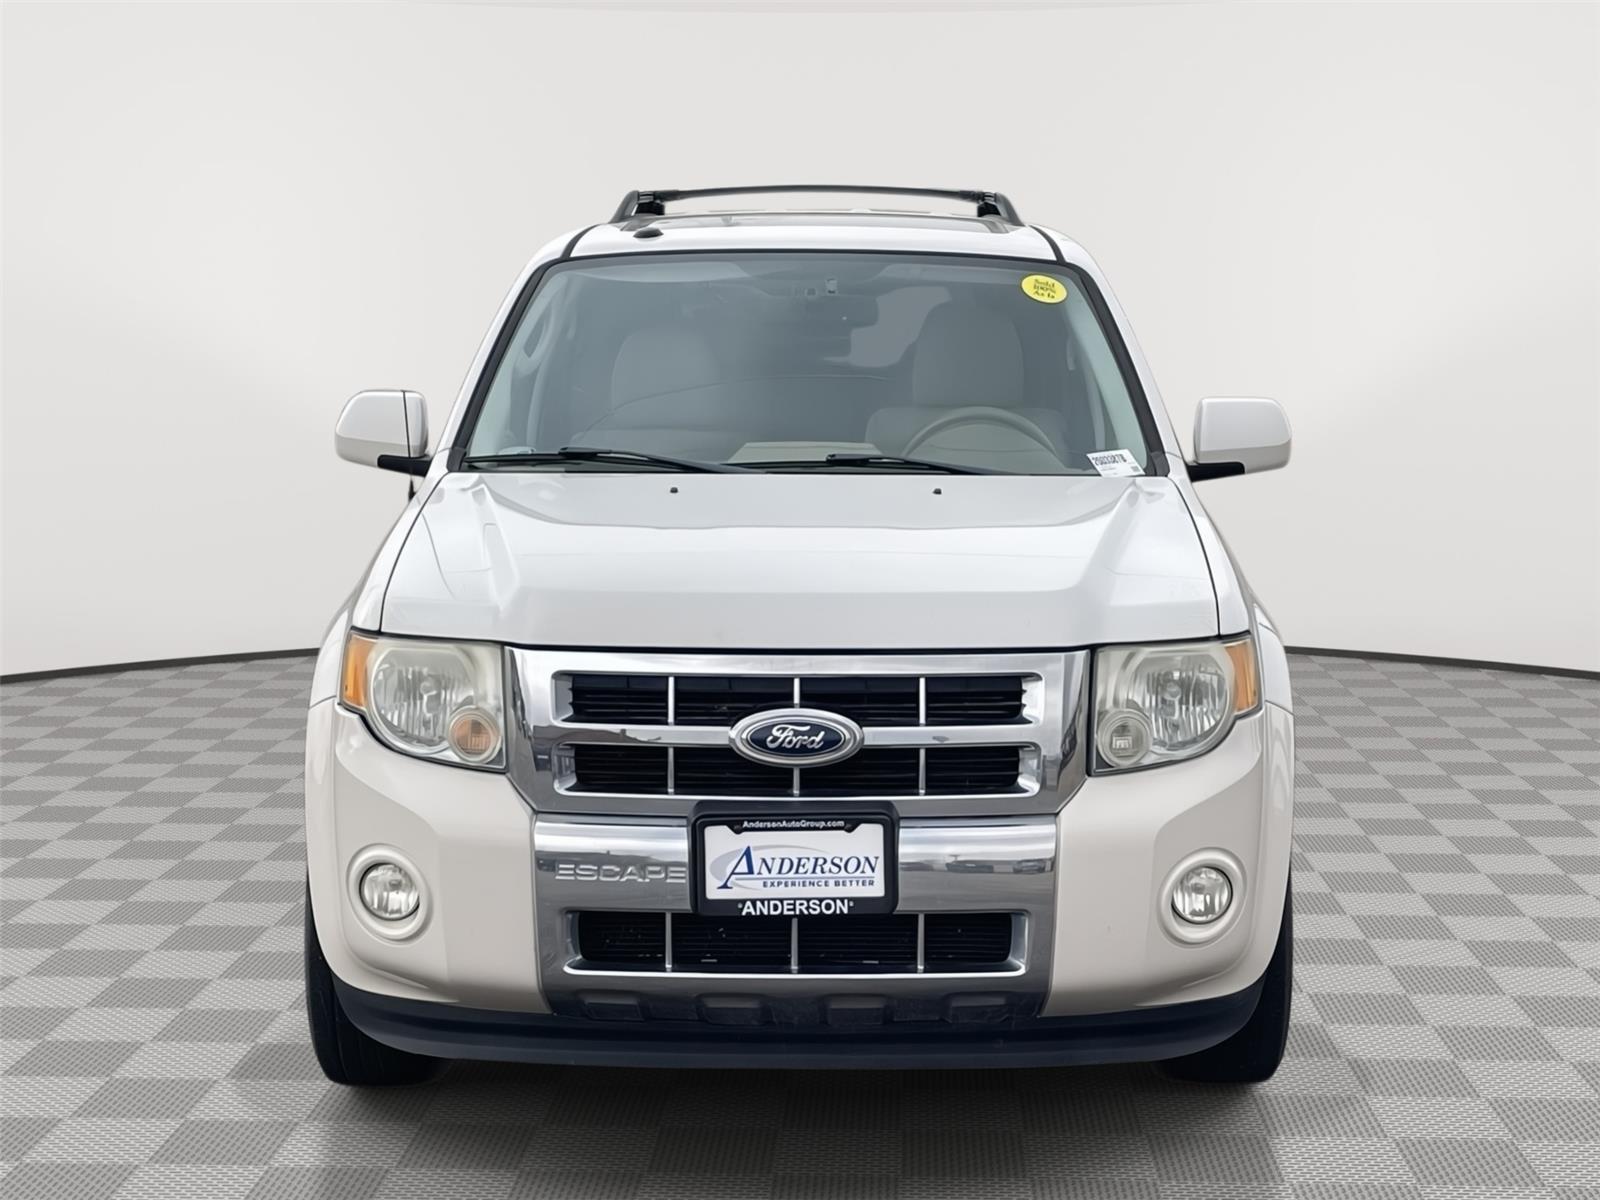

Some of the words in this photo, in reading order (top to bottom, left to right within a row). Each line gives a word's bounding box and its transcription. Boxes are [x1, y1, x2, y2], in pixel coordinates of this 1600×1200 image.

[766, 724, 825, 749] Ford
[742, 820, 845, 829] AndersonAutoGroup.com
[555, 864, 687, 883] ESCAPE
[762, 879, 830, 889] EXPERIENCE
[834, 879, 875, 888] BETTER
[741, 899, 849, 916] ANDERSON
